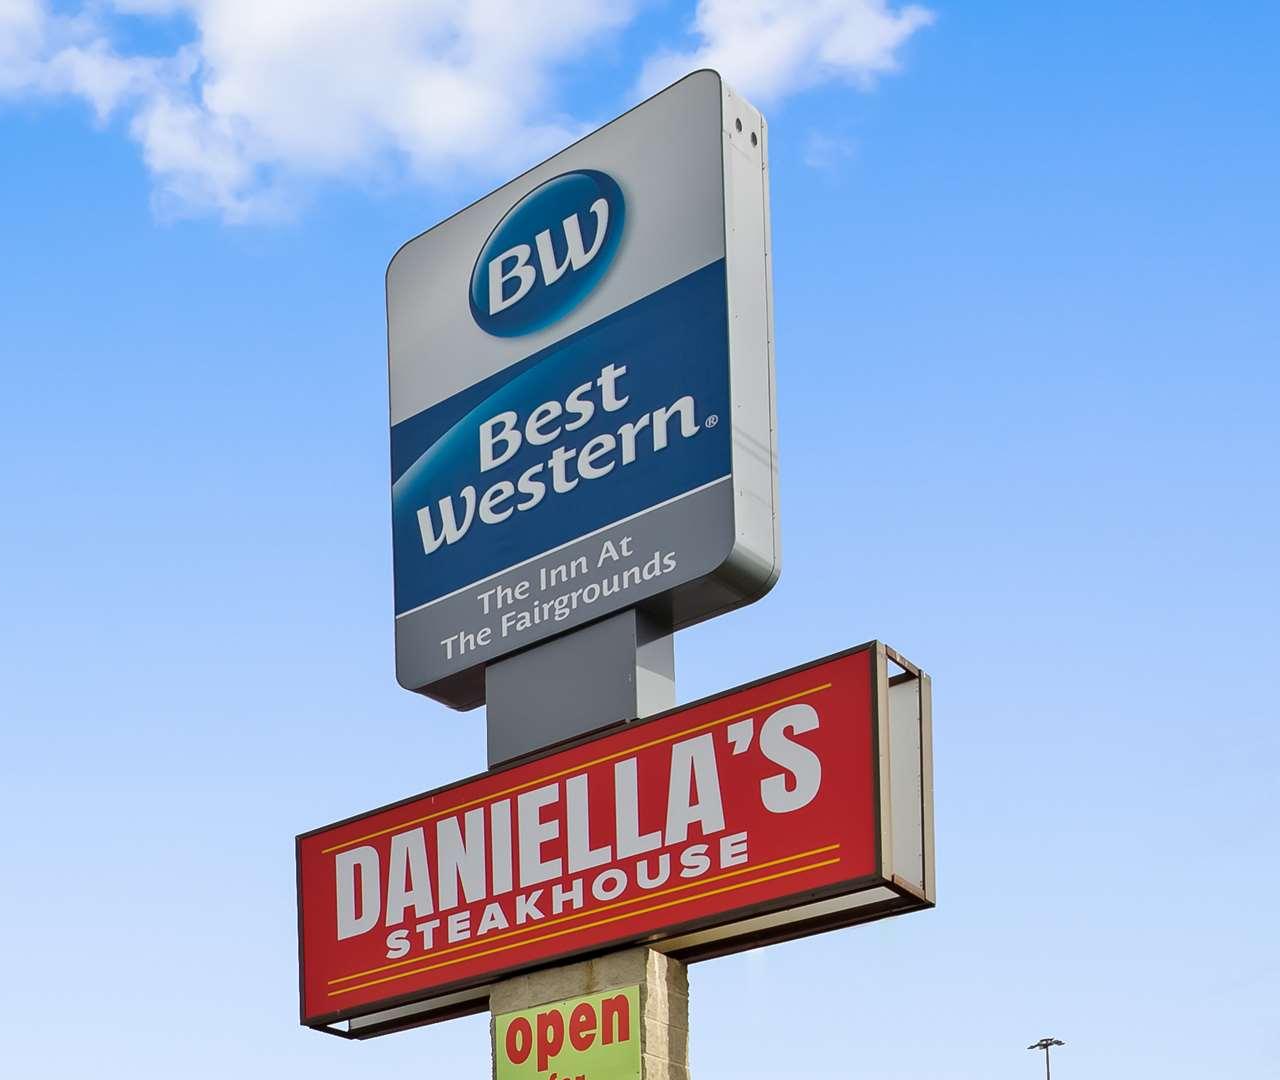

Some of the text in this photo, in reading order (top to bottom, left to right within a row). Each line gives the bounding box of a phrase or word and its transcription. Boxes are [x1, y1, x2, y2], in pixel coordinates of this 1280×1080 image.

[489, 197, 609, 316] BW
[478, 362, 630, 473] Best
[440, 551, 677, 660] The Fairgrounds
[477, 535, 633, 615] The Inn At
[335, 702, 822, 941] DANIELLA'S
[386, 831, 750, 960] STEAKHOUSE
[505, 992, 631, 1072] open
